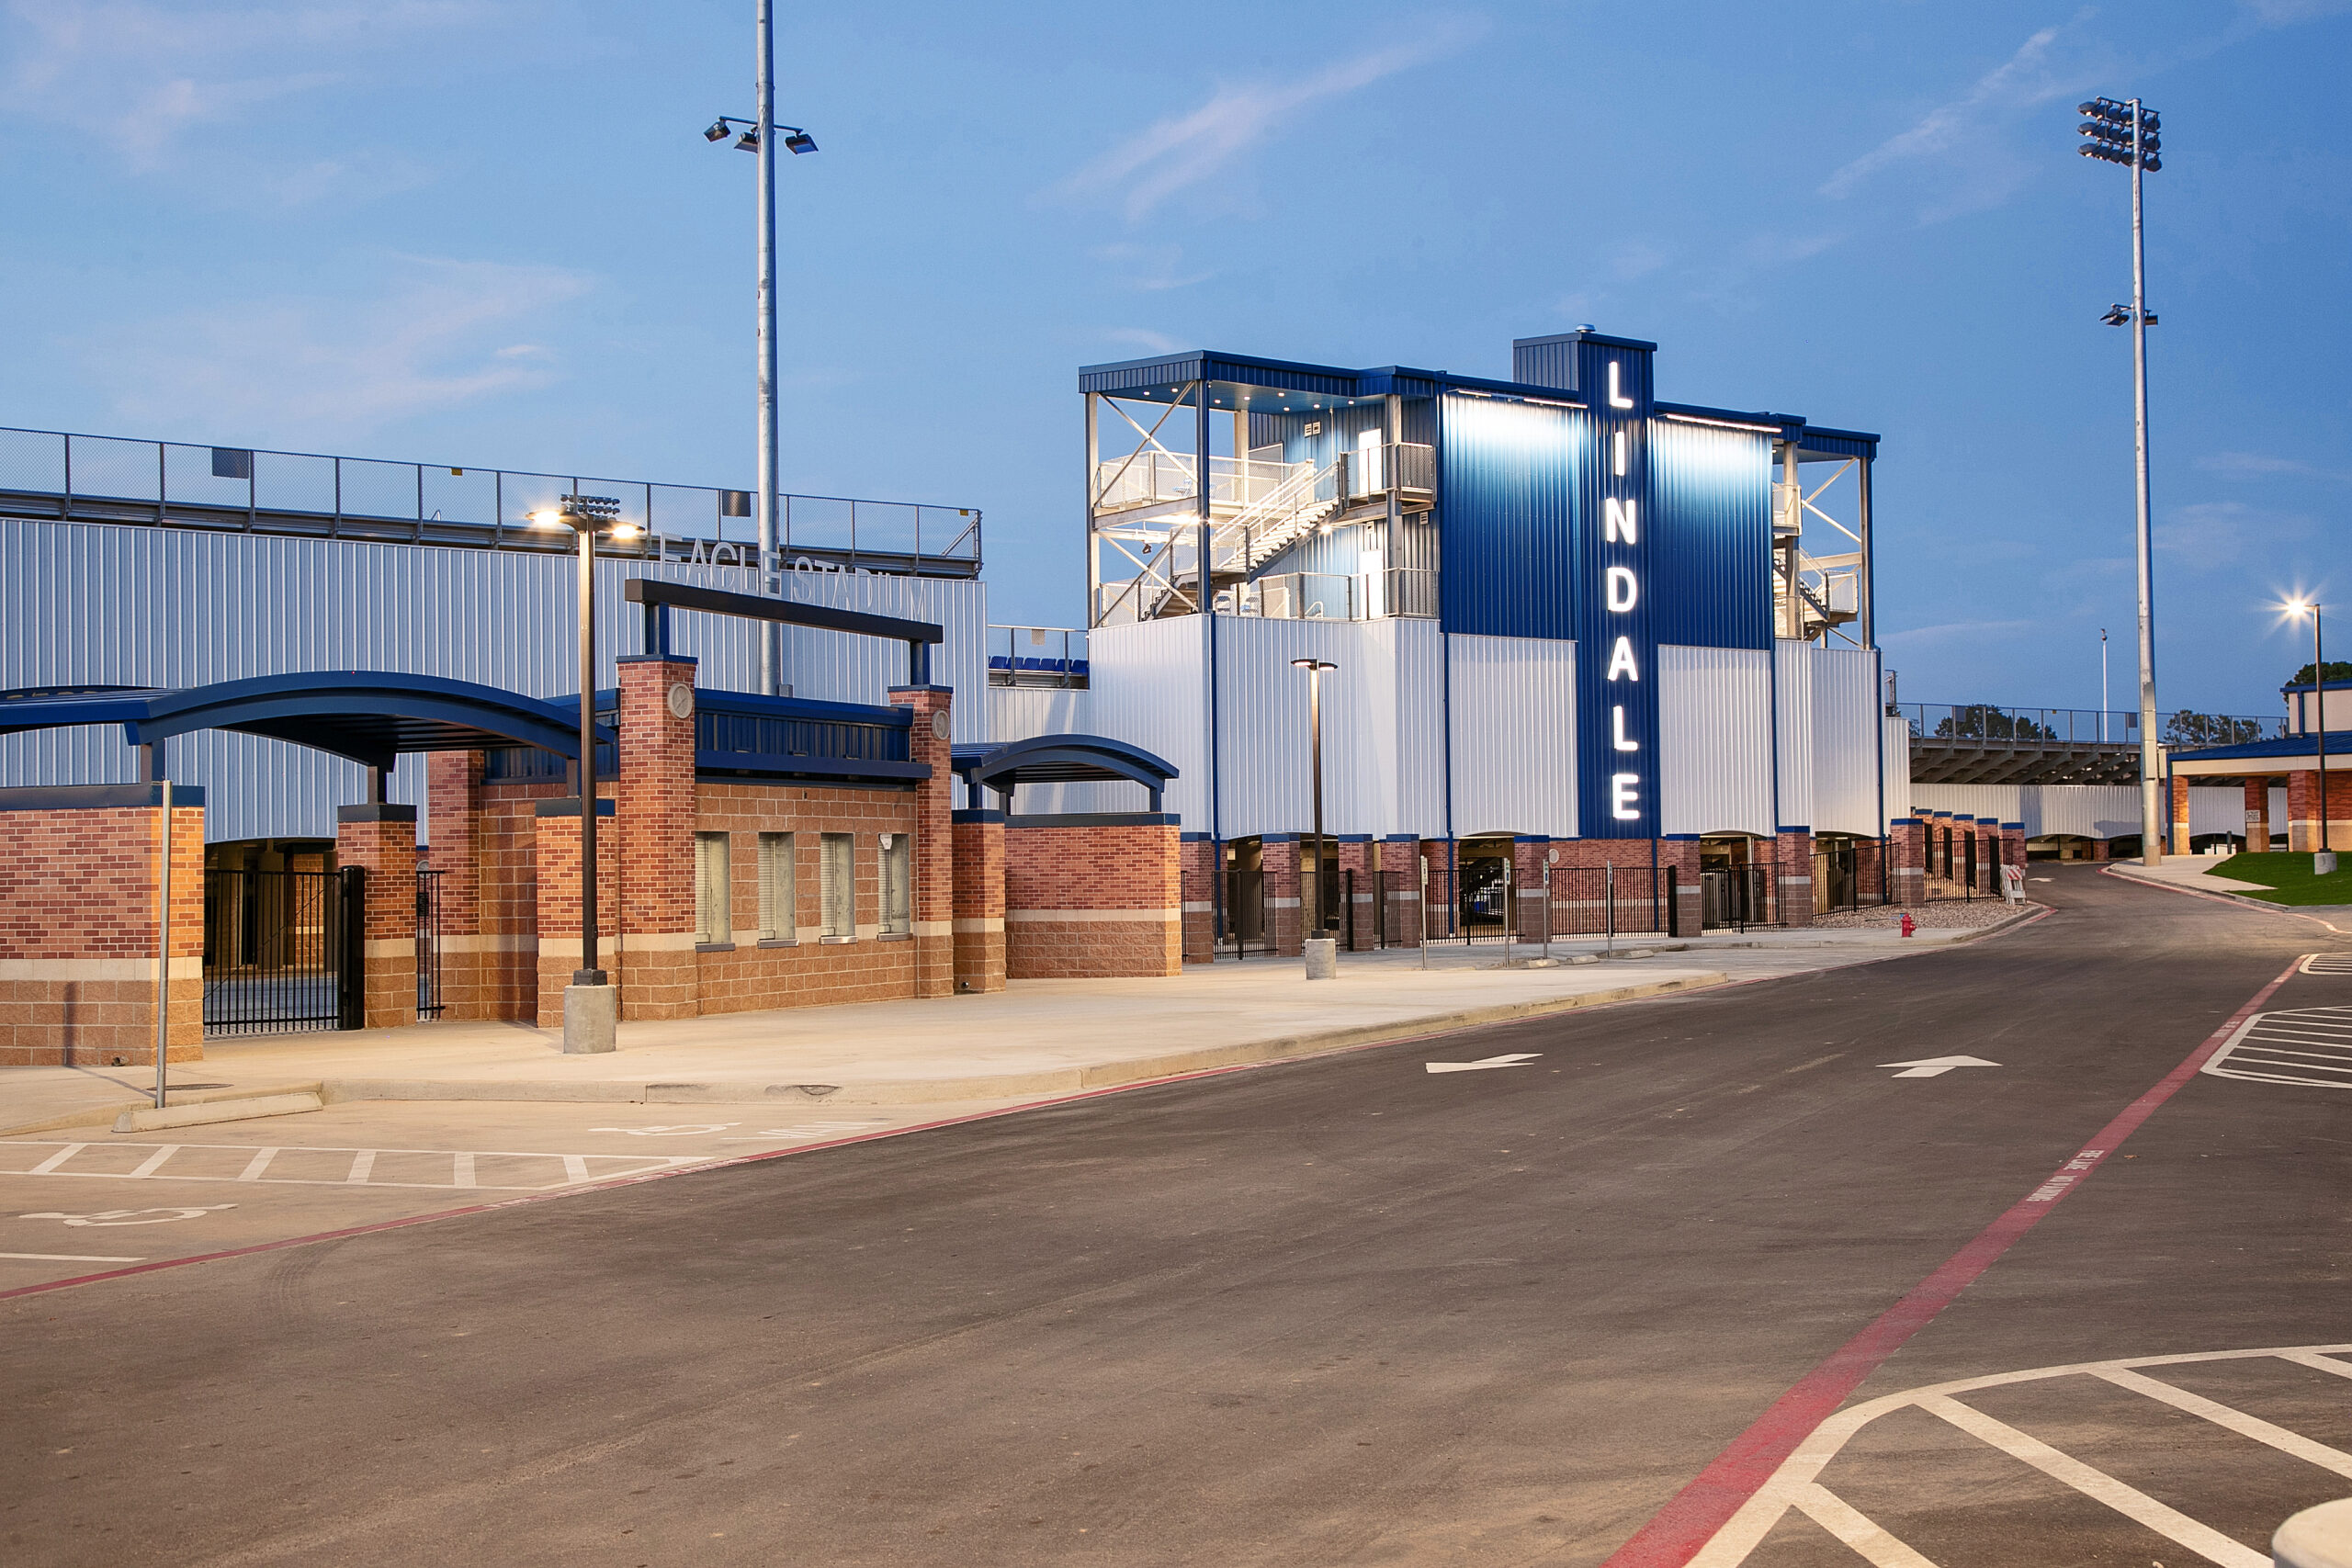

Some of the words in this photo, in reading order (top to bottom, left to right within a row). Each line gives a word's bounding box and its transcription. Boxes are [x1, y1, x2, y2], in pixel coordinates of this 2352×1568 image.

[660, 532, 782, 599] EAGLE
[793, 556, 927, 623] STADIUM
[1605, 361, 1640, 819] LINDALE
